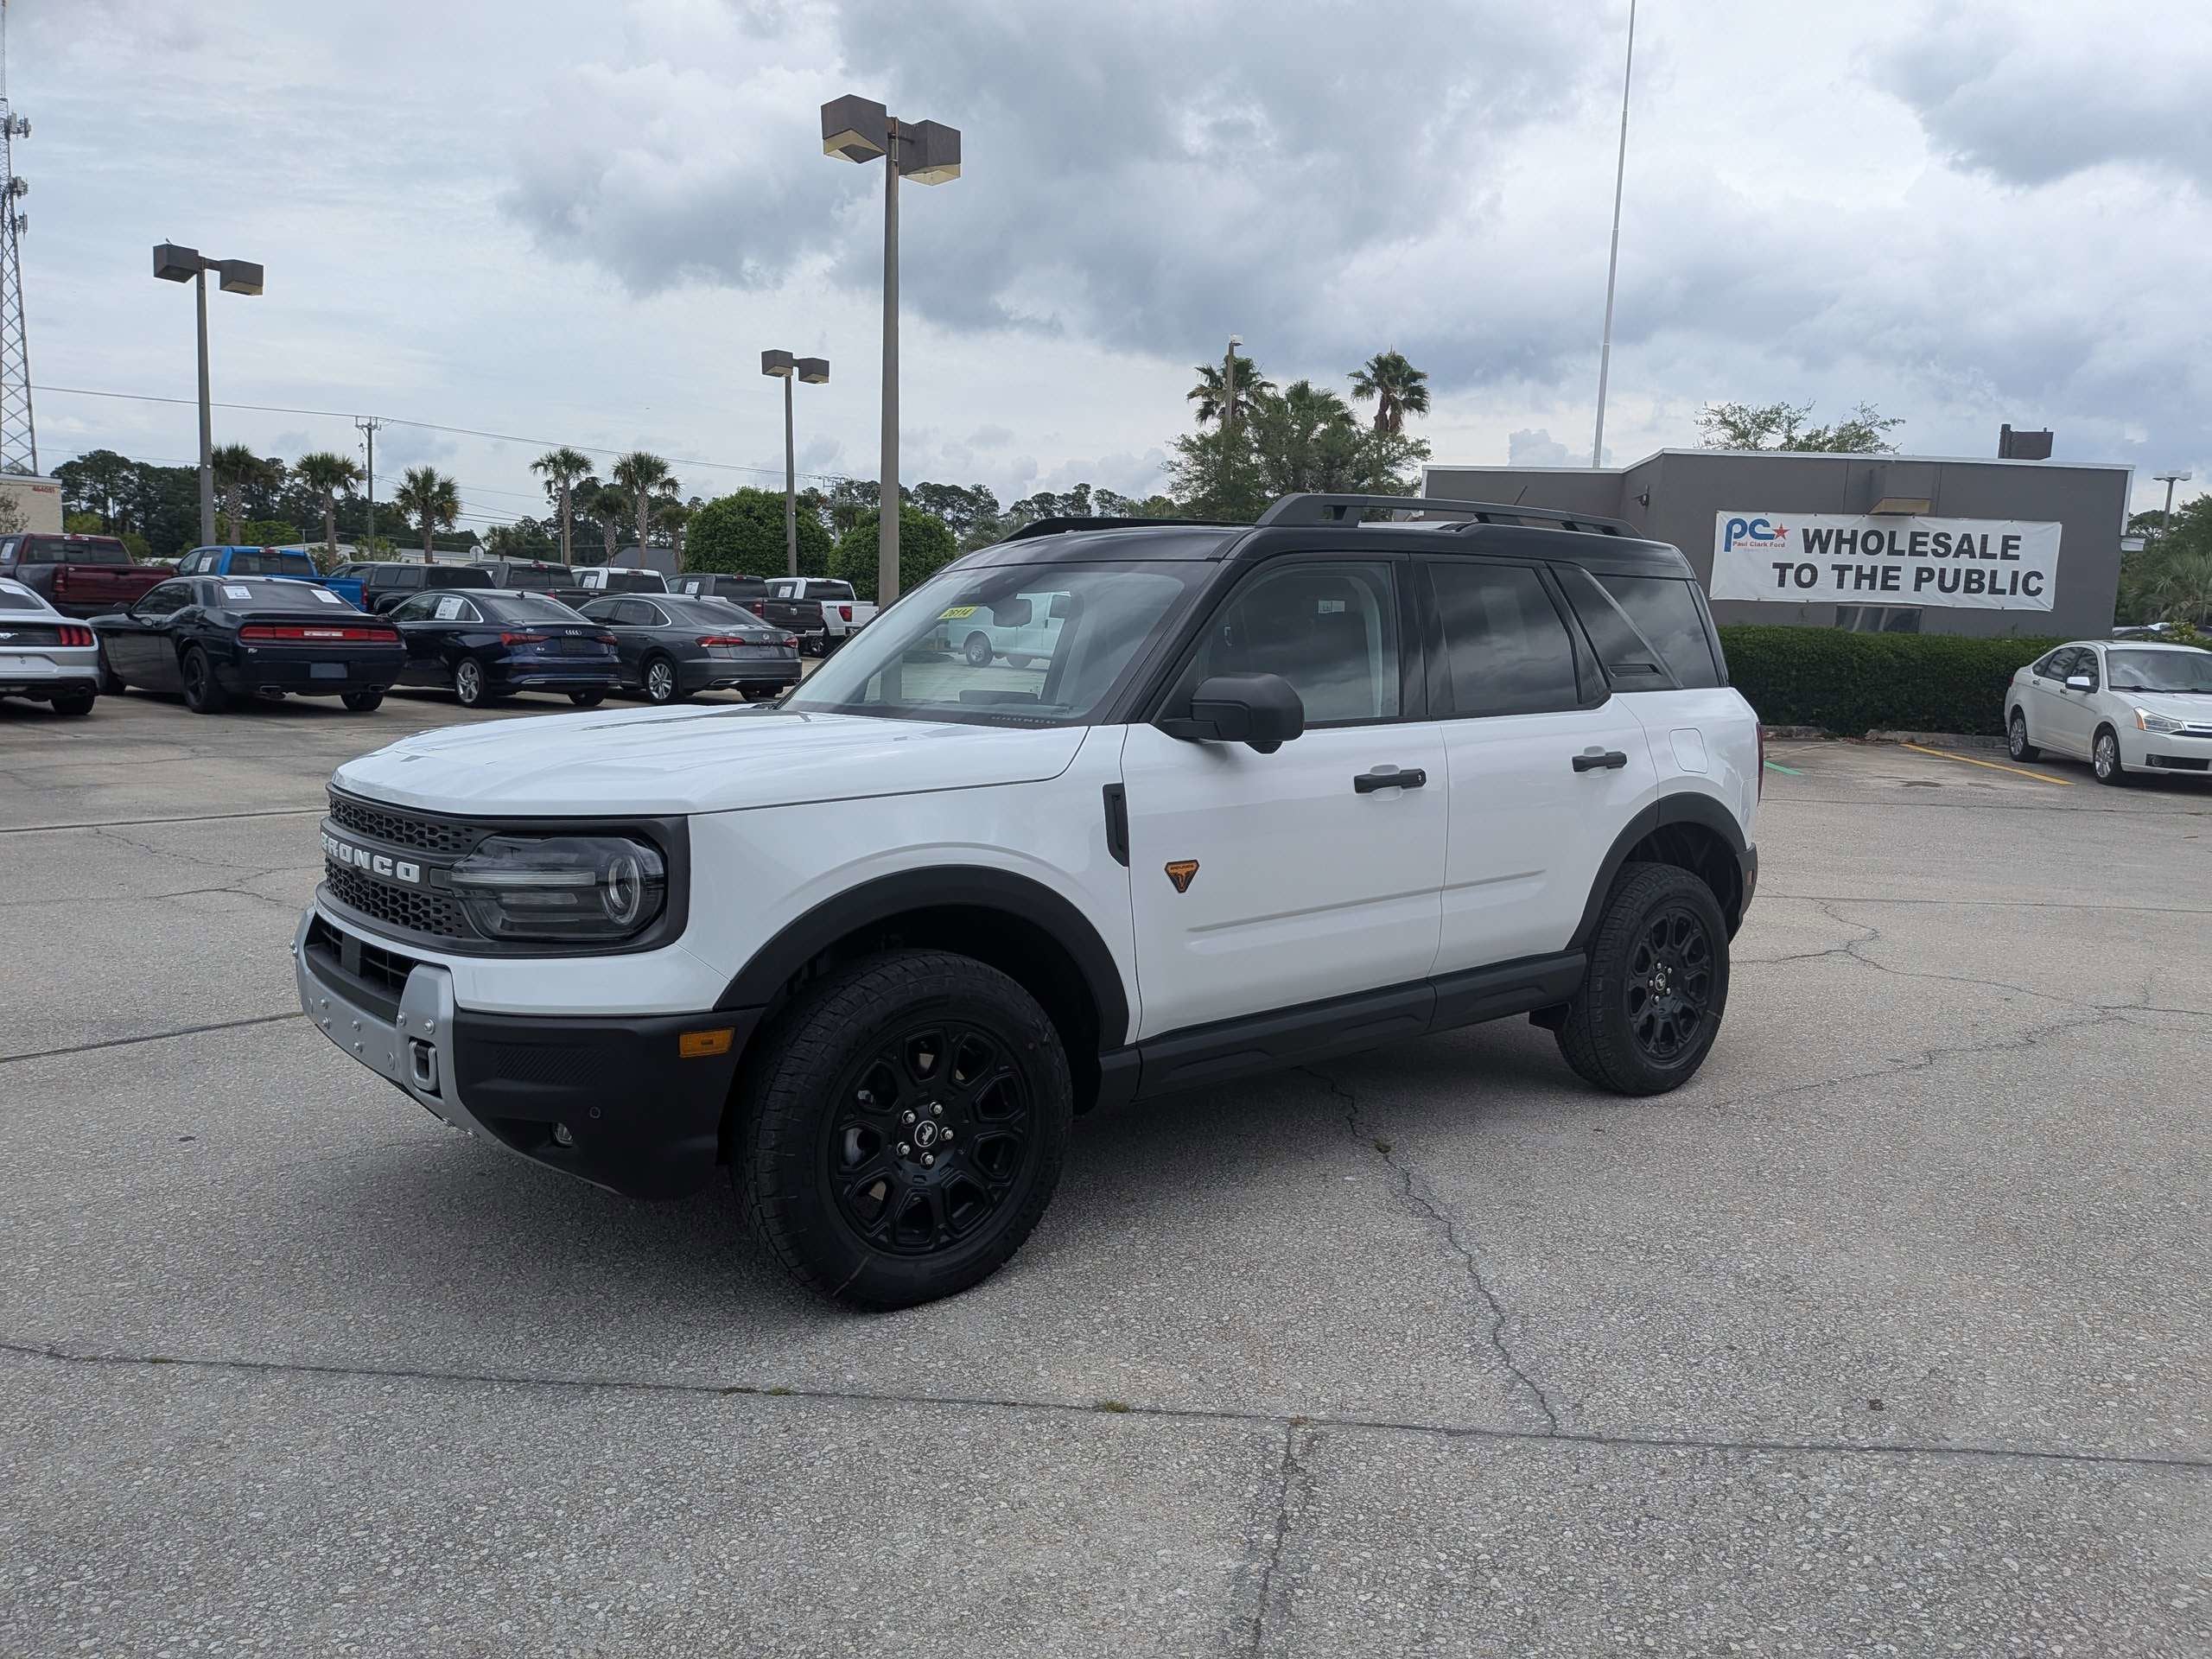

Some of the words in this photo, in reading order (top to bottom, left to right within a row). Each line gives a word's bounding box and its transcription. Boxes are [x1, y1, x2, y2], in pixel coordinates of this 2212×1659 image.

[1802, 528, 2022, 561] WHOLESALE
[1772, 563, 1818, 588] TO
[1831, 563, 1902, 591] THE
[1913, 566, 2044, 597] PUBLIC
[321, 831, 420, 883] BRONCO
